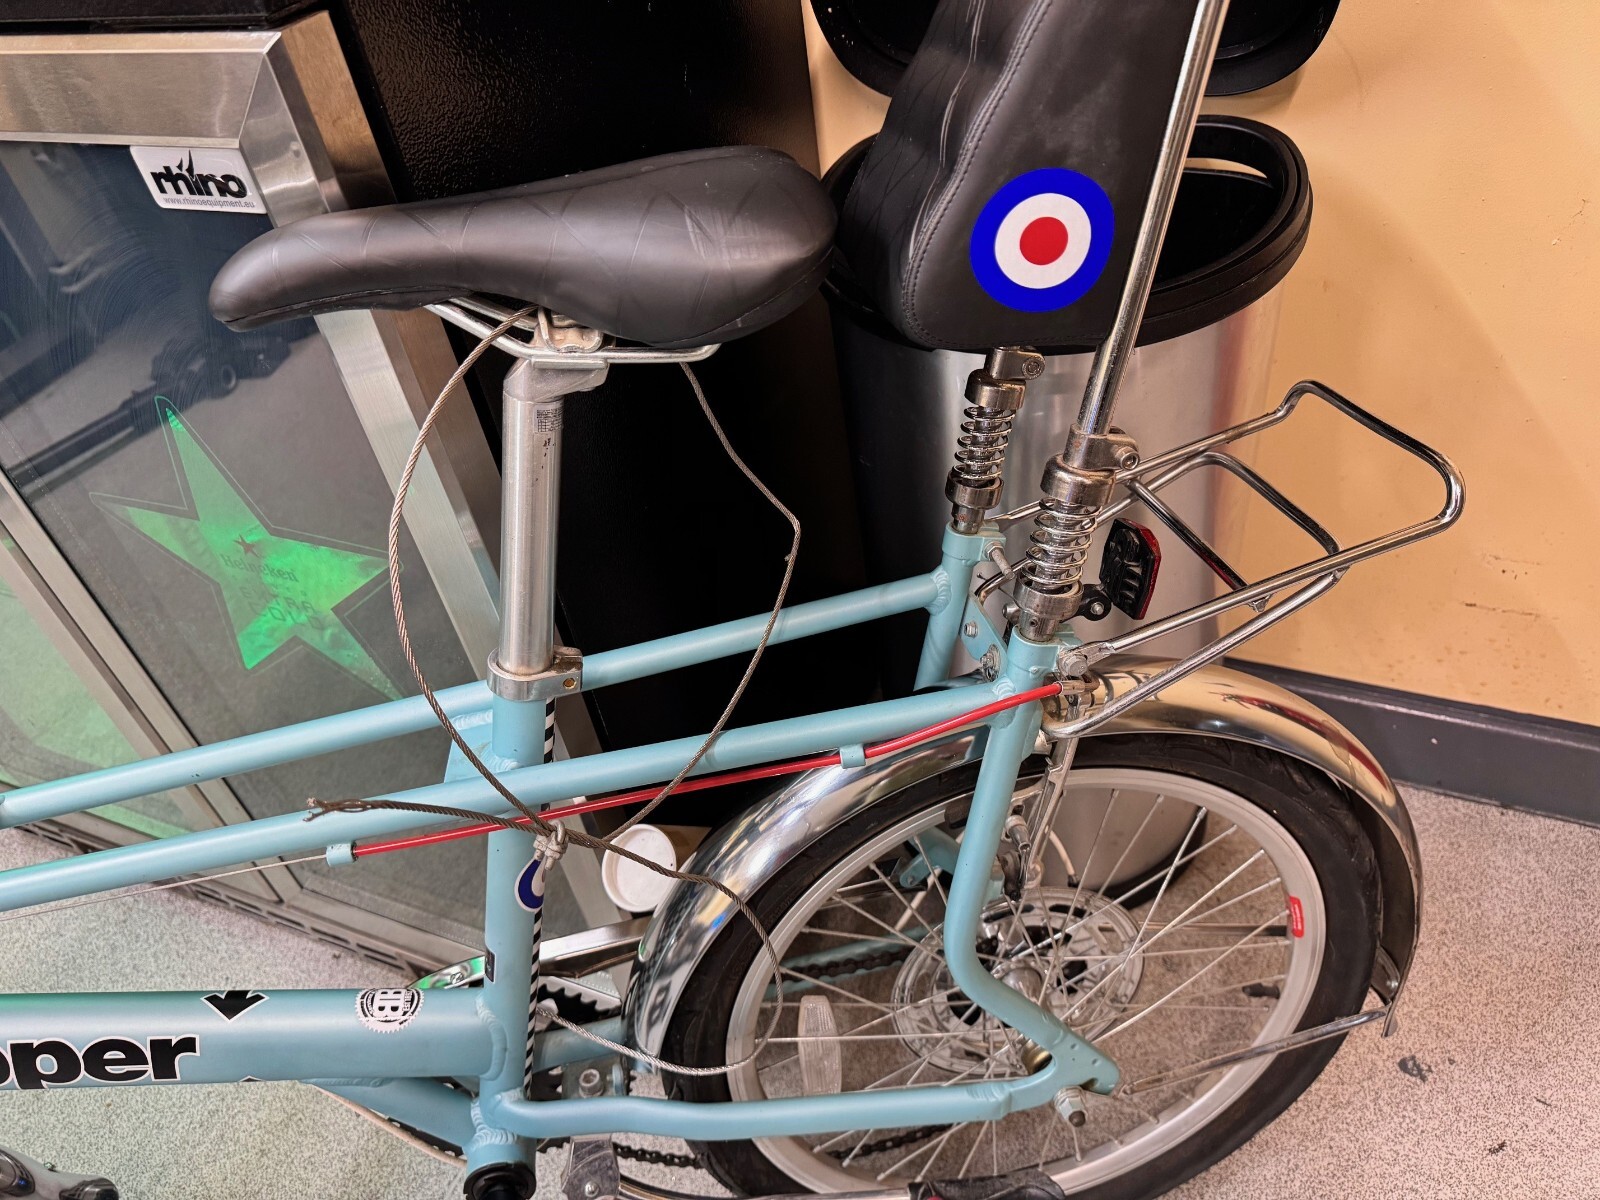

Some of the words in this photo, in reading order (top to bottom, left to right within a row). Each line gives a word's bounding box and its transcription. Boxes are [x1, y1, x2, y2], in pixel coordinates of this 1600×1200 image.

[150, 150, 247, 198] rhino
[163, 196, 255, 208] www.rhinoequipment.eu
[220, 554, 298, 582] Heineken
[0, 1034, 200, 1089] per
